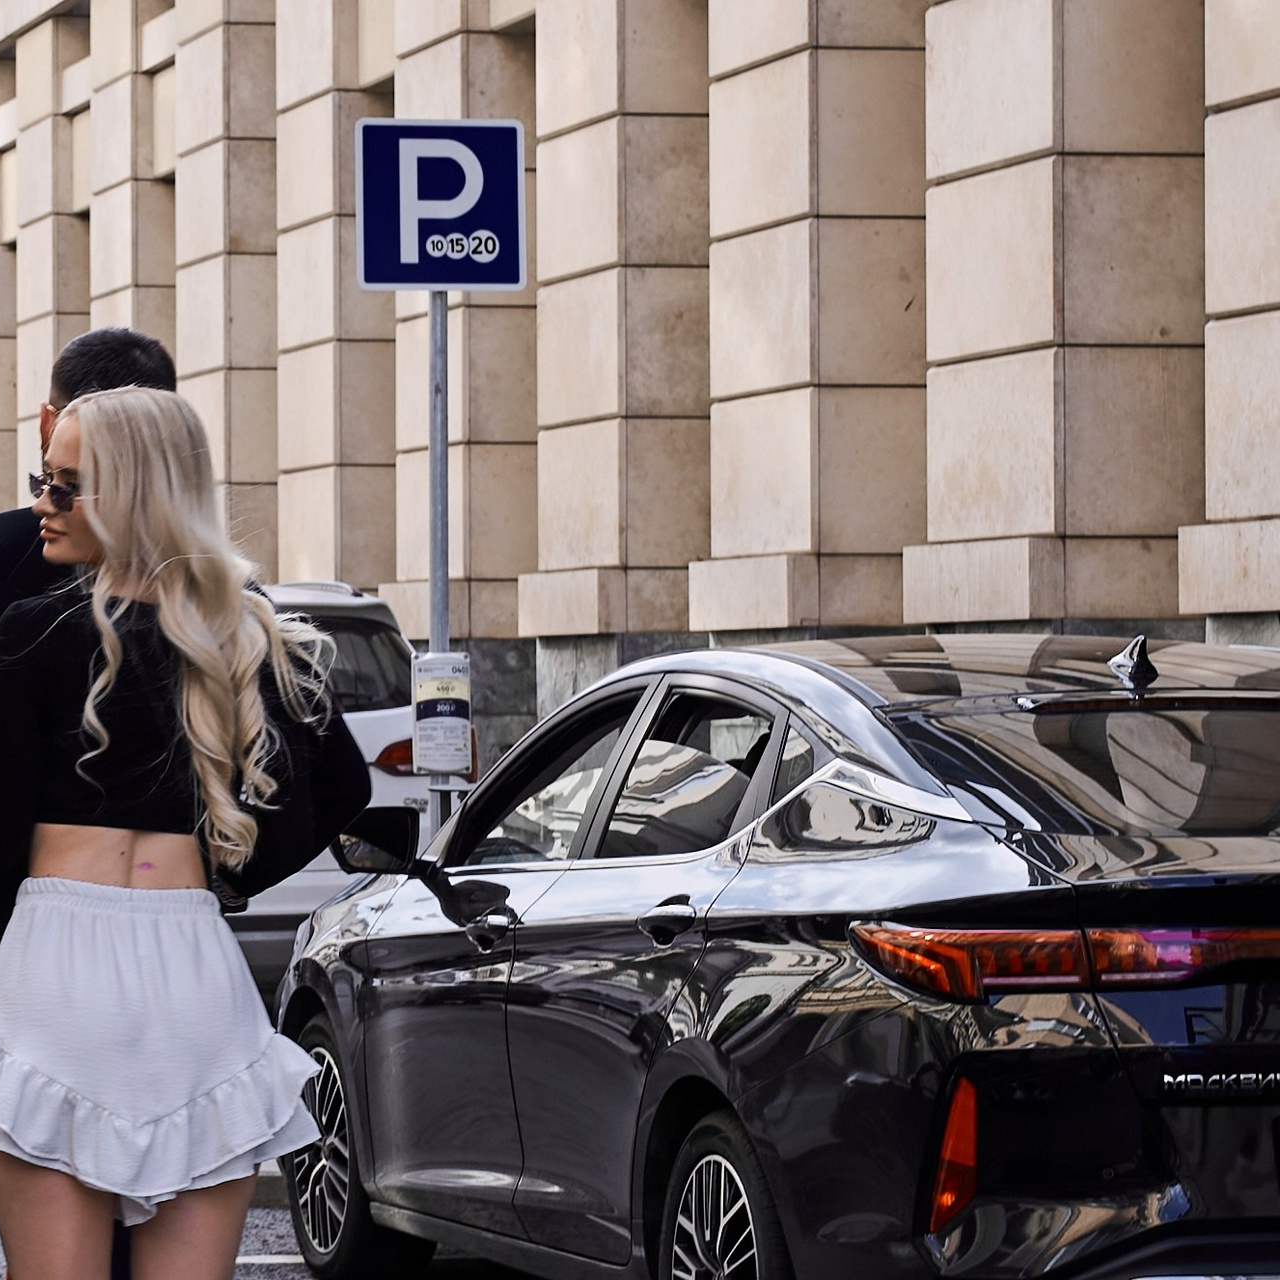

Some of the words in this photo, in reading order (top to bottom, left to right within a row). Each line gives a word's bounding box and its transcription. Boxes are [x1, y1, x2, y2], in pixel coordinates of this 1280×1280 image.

[399, 138, 484, 264] P
[431, 239, 444, 252] 10
[449, 238, 465, 253] 15
[471, 236, 497, 255] 20
[1163, 1073, 1280, 1090] МОСКВИ
